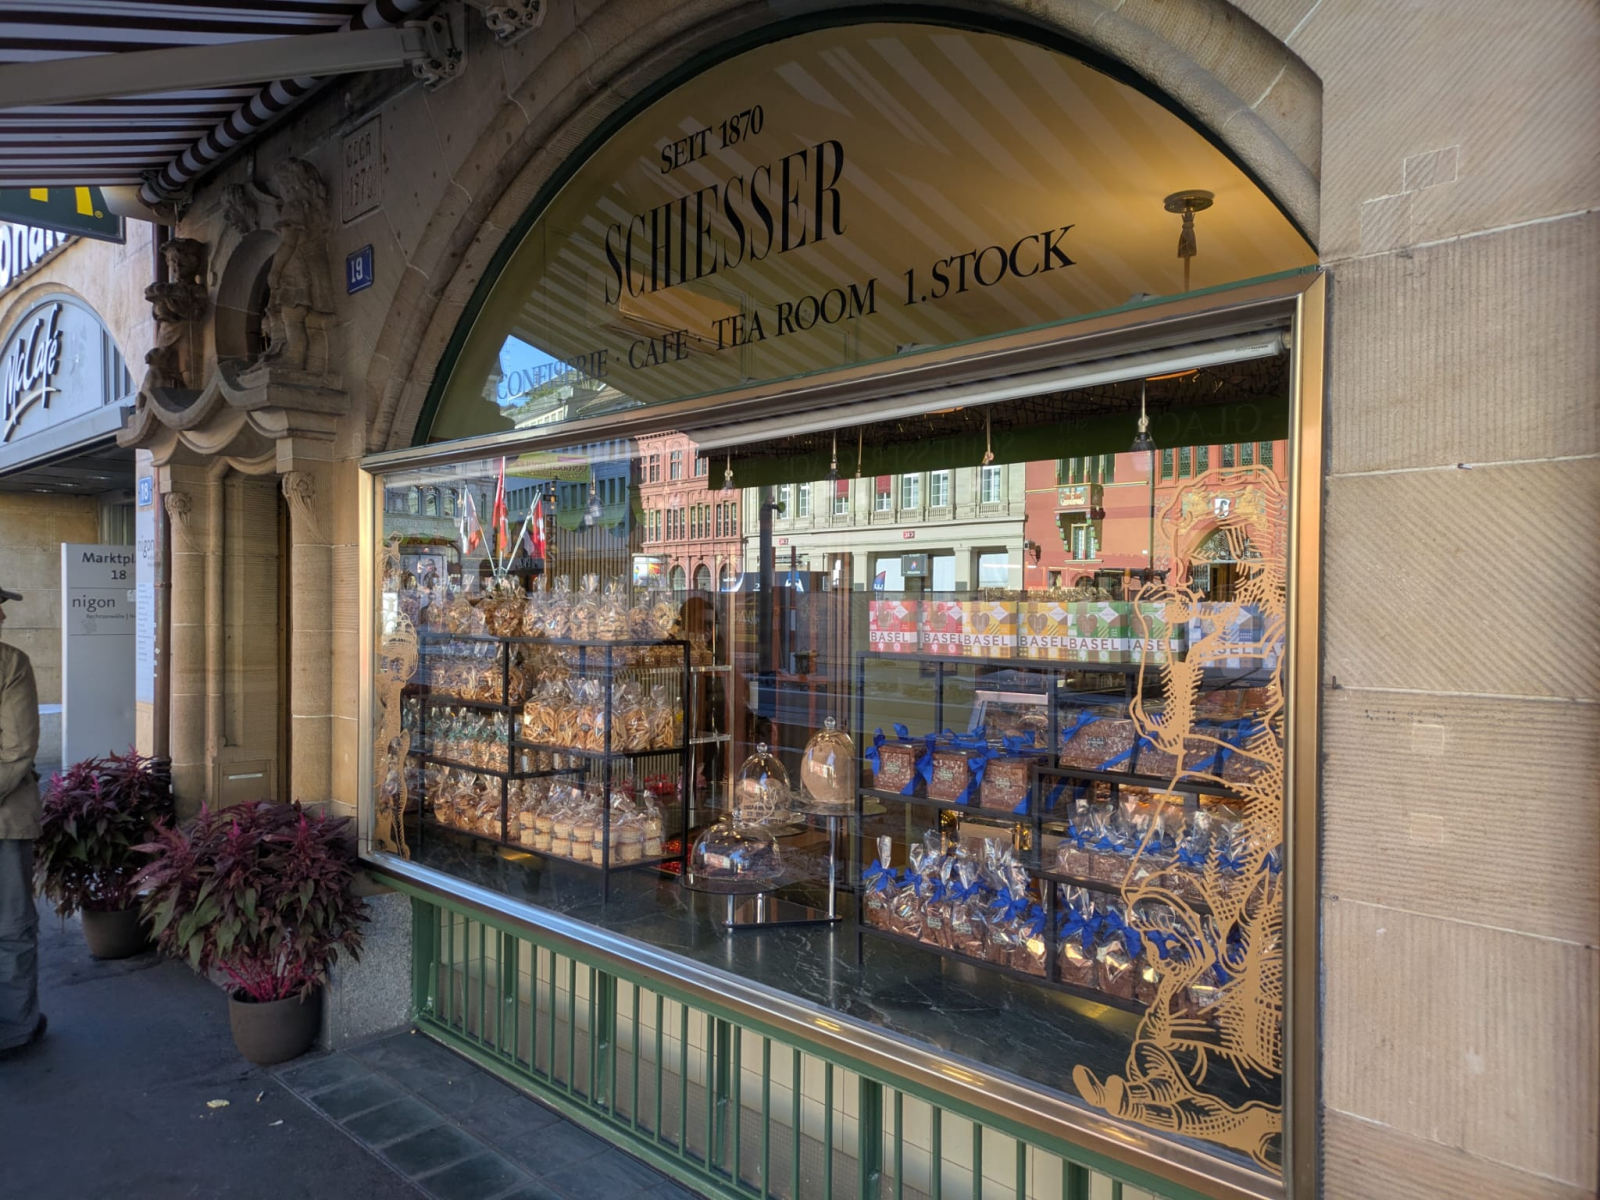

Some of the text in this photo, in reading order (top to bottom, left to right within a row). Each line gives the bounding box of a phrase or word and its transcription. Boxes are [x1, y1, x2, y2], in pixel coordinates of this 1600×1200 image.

[661, 104, 764, 175] SEIT 1870
[604, 139, 848, 307] SCHIESSER
[351, 257, 363, 283] 19
[628, 329, 689, 370] CAFE
[711, 310, 767, 351] TEA
[775, 278, 878, 338] ROOM
[3, 302, 63, 425] McCafé
[141, 482, 149, 500] 18
[111, 570, 127, 580] 18
[72, 594, 116, 613] nigon
[870, 632, 908, 643] BASEL
[924, 633, 963, 644] BASEL
[964, 635, 1009, 647] BASEL
[1020, 636, 1068, 648] BASEL
[1069, 638, 1119, 650] BASEL
[1133, 640, 1177, 652] ASEL
